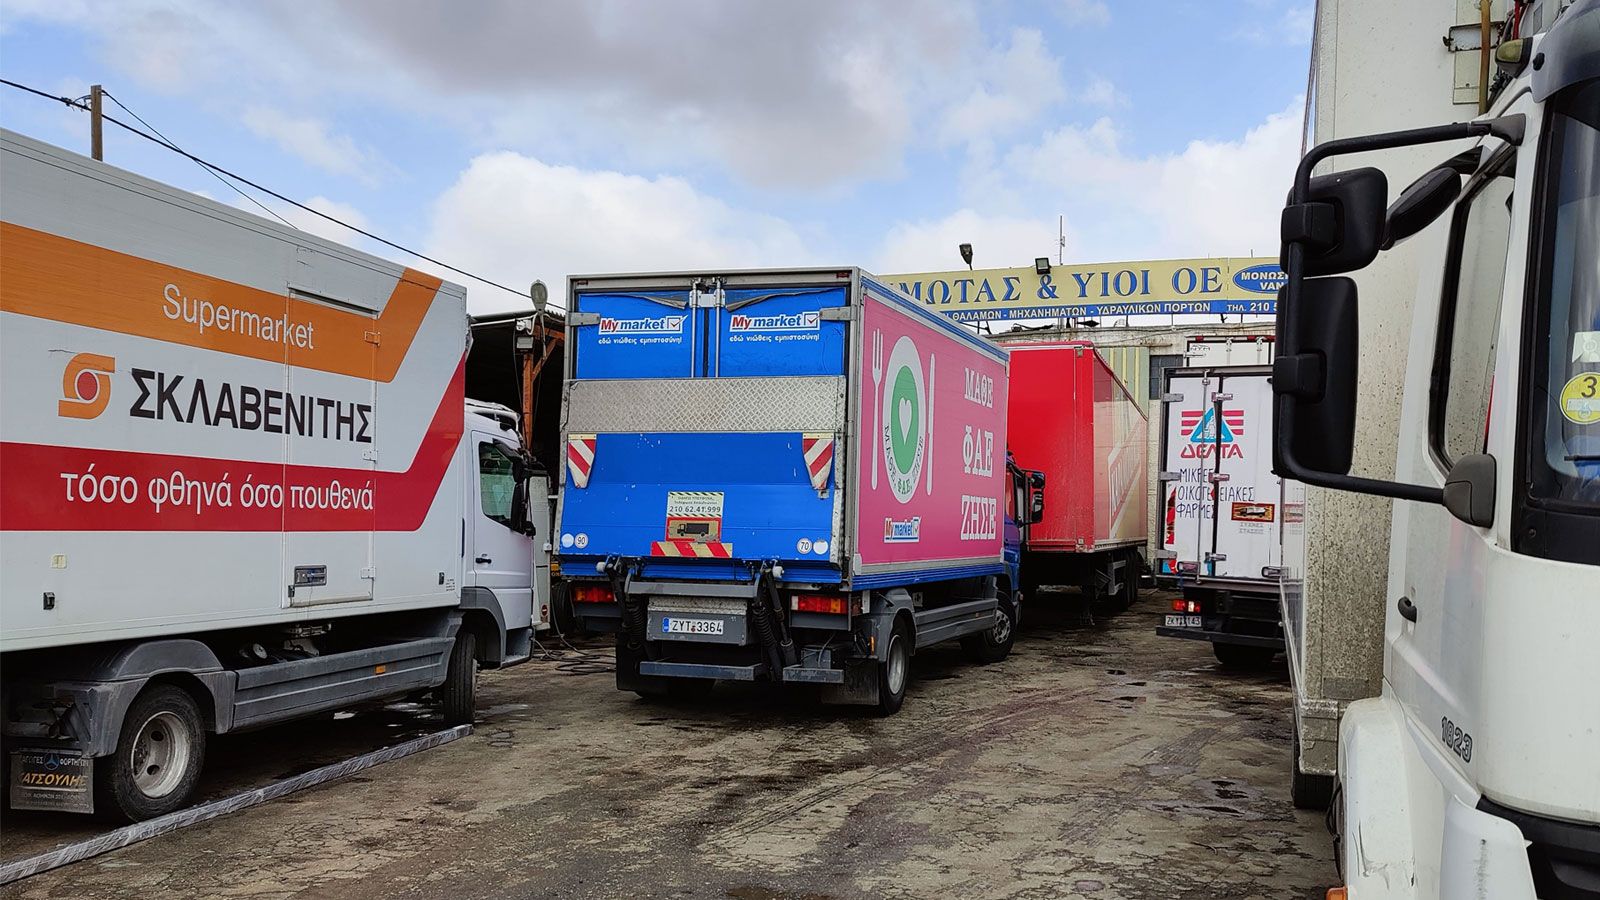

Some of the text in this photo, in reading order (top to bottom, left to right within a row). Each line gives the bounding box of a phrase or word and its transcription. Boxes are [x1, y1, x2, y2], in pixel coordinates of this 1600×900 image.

[891, 266, 1223, 304] ΜΩΤΑΣ & ΥΙΟΙ ΟΕ
[161, 282, 315, 351] Supermarket
[601, 319, 665, 332] My market
[731, 315, 802, 330] My market
[952, 311, 1001, 321] ΘΑΛΑΜΩΝ
[1009, 307, 1087, 318] ΜΗΧΑΝΗΜΑΤΩΝ
[1096, 304, 1161, 315] ΥΔΡΑΥΛΙΚΩΝ
[1164, 302, 1211, 313] ΠΟΡΤΩΝ
[1250, 302, 1270, 311] 210
[129, 367, 373, 444] ΣΚΛΑΒΕΝΙΤΗΣ
[963, 367, 993, 409] ΜΑΘΕ
[1581, 376, 1598, 398] 3
[962, 425, 994, 478] ΦΑΕ
[60, 463, 374, 515] τόσο φθηνά όσο πουθενά
[1177, 485, 1255, 502] ΟΙΚΟΓΕΕΙΑΚΕΣ
[1180, 467, 1215, 482] ΜΙΚΡΕ
[960, 494, 997, 541] ΖΗΣΕ
[1441, 715, 1473, 764] 1823
